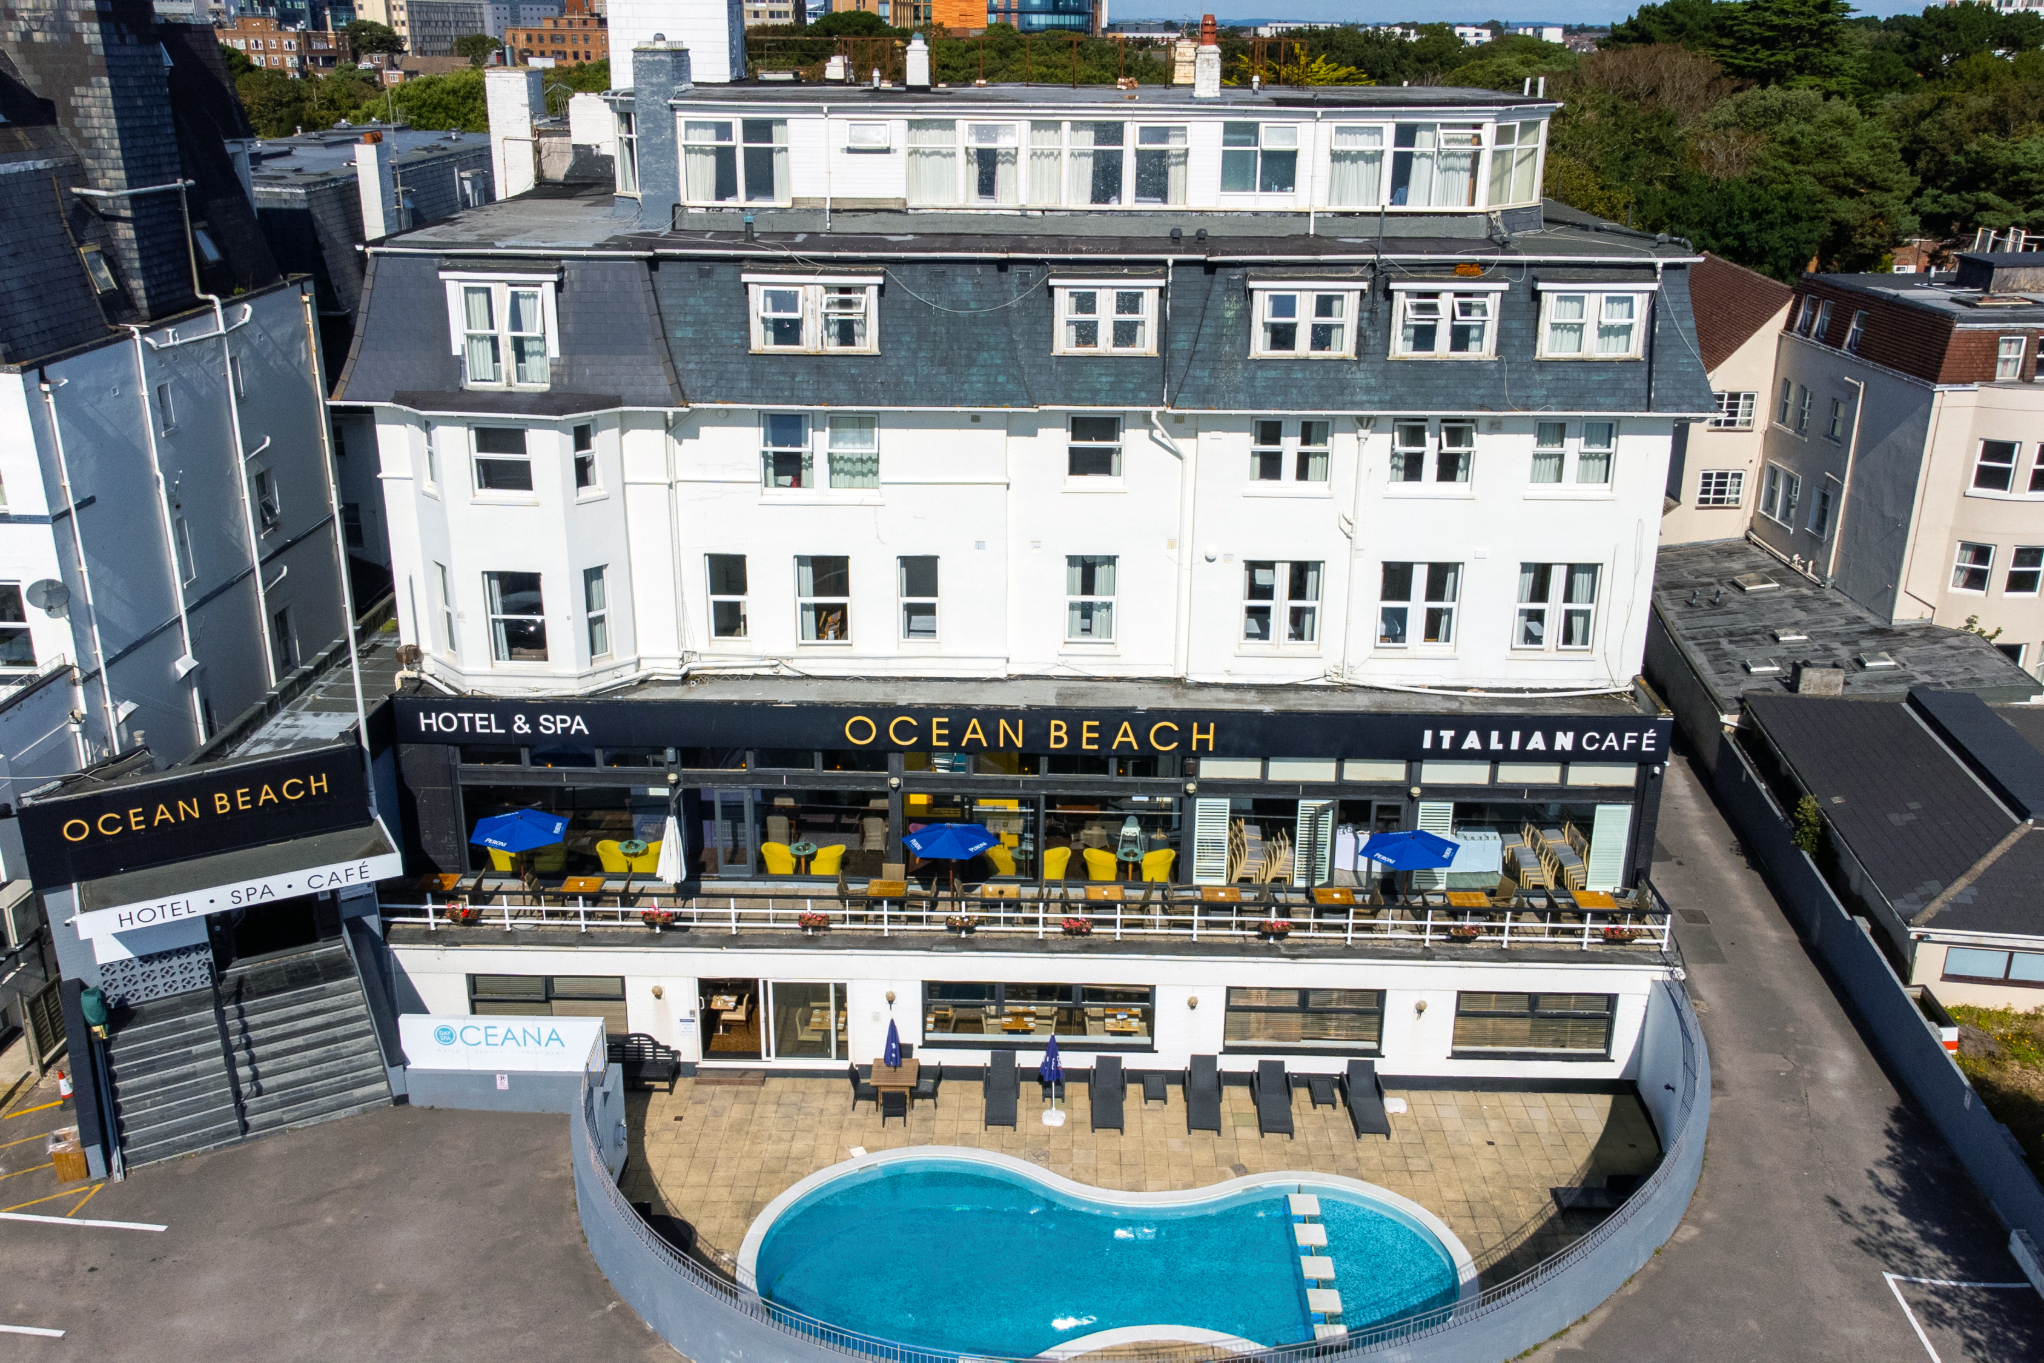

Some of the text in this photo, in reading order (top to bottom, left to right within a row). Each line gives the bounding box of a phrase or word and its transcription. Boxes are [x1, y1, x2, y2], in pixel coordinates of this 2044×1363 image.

[419, 712, 590, 735] HOTEL & SPA
[844, 715, 1216, 752] OCEAN BEACH
[1422, 728, 1657, 752] ITALIAN CAFÉ
[62, 773, 329, 843] OCEAN BEACH
[484, 837, 507, 848] PERONI
[1373, 852, 1396, 864] PERONI
[118, 861, 370, 928] HOTEL SPA CAFÉ
[433, 1024, 566, 1048] OCEANA
